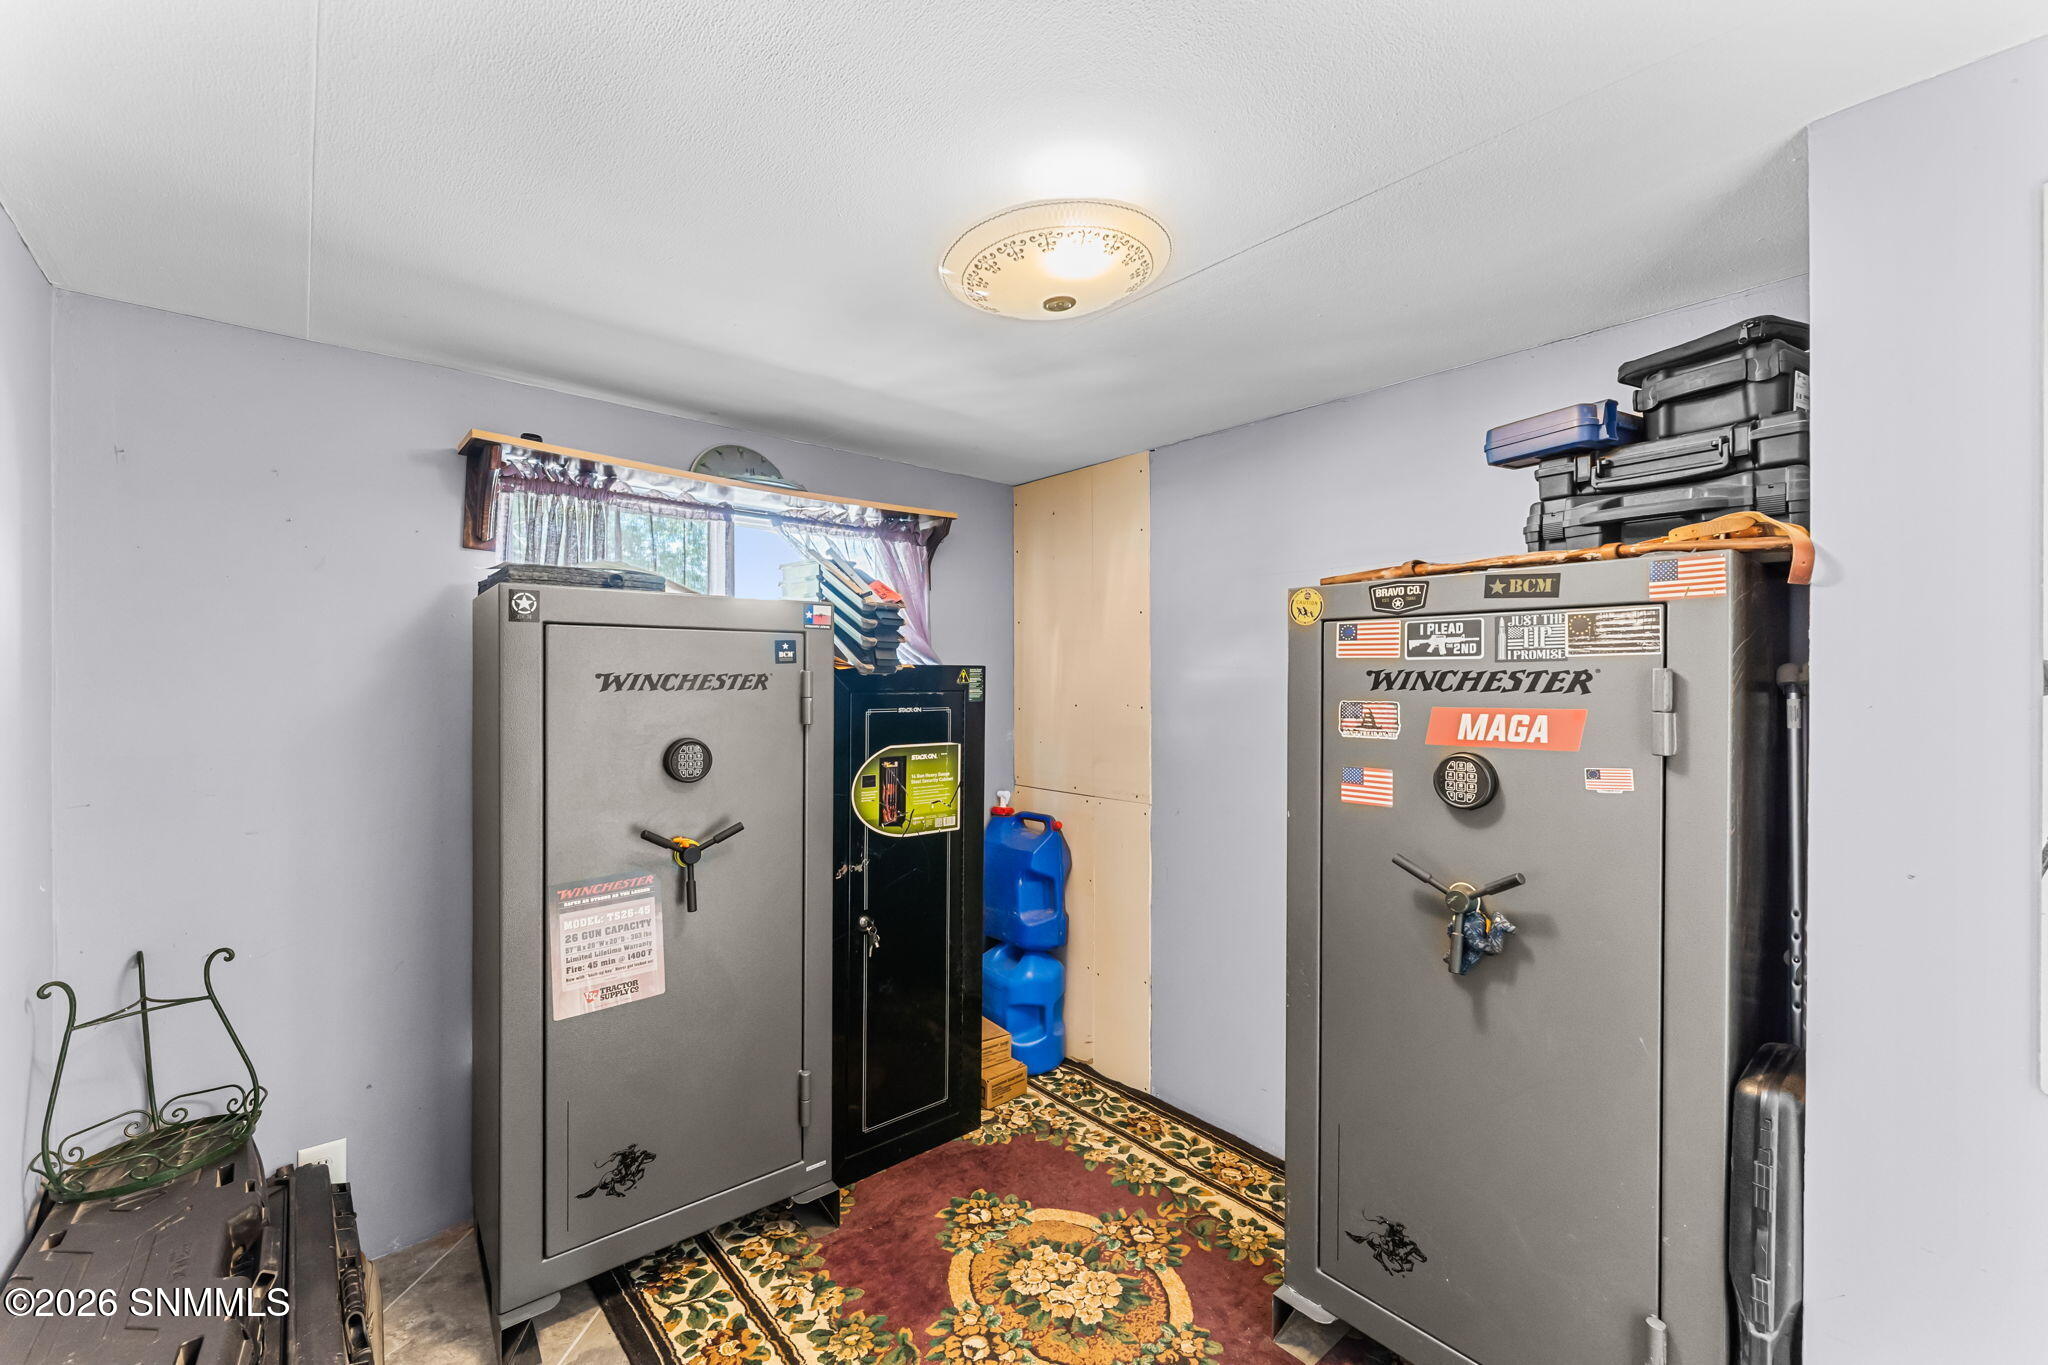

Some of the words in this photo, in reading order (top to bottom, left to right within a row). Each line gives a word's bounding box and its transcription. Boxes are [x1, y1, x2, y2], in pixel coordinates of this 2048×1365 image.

[1375, 586, 1405, 598] BRAVO
[1406, 585, 1421, 595] CO.
[1508, 578, 1553, 593] BCM
[1420, 624, 1424, 635] I
[1427, 622, 1464, 635] PLEAD
[1507, 615, 1539, 627] JUST
[1540, 613, 1565, 625] THE
[1522, 626, 1552, 649] TIP
[1453, 642, 1477, 654] 2ND
[1507, 650, 1512, 660] I
[1513, 648, 1566, 660] PROMISE
[595, 672, 769, 692] WINCHESTER
[1366, 668, 1594, 696] WINCHESTER
[1457, 713, 1549, 744] MAGA
[557, 875, 655, 900] WINCHESTER
[563, 915, 604, 930] MODEL:
[606, 905, 651, 921] TS26-45
[564, 933, 578, 944] 26
[581, 928, 602, 940] GUN
[604, 918, 652, 936] CAPACITY
[565, 952, 593, 964] Limited
[594, 946, 622, 958] Lifetime
[623, 940, 653, 951] Warranty
[565, 965, 585, 975] Fire:
[587, 961, 598, 970] 45
[600, 958, 616, 967] min
[600, 980, 639, 995] TRACTOR
[600, 988, 629, 1001] SUPPLY
